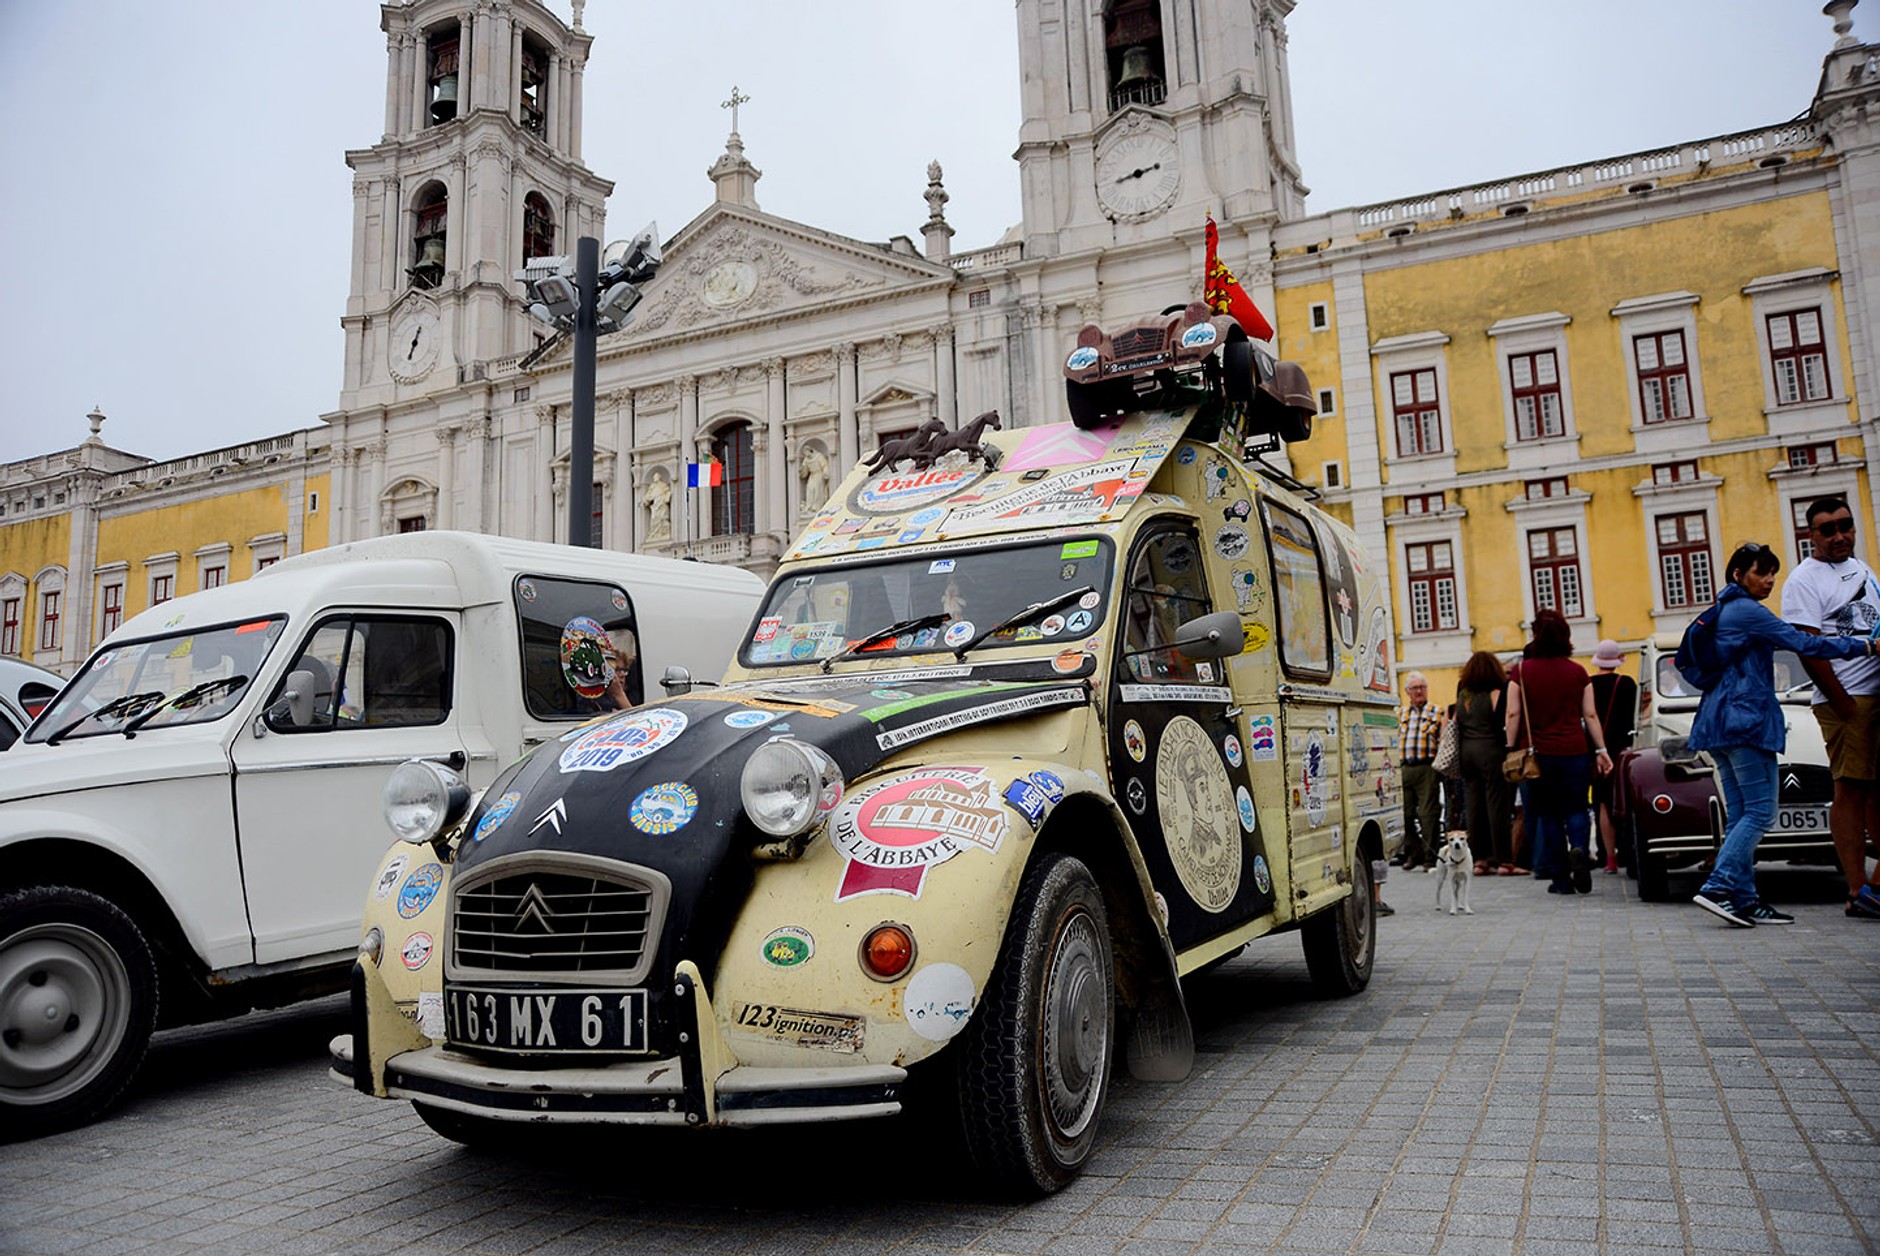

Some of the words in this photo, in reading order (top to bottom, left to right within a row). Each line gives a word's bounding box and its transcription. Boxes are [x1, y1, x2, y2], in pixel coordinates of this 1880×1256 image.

[953, 488, 1037, 521] Biscuiterie
[1040, 479, 1058, 493] de
[1059, 463, 1127, 487] l'Abbaye
[1071, 612, 1086, 627] A
[566, 749, 624, 769] 2019
[678, 783, 699, 807] CLUB
[849, 770, 979, 807] BISCUITERIE
[1018, 789, 1043, 815] bleu
[631, 813, 677, 835] CASSIS
[1779, 810, 1828, 829] 0651
[836, 822, 852, 844] DE
[849, 836, 958, 866] L'ABBAYE
[450, 992, 498, 1044] 163
[510, 996, 556, 1046] MX
[581, 995, 632, 1047] 61
